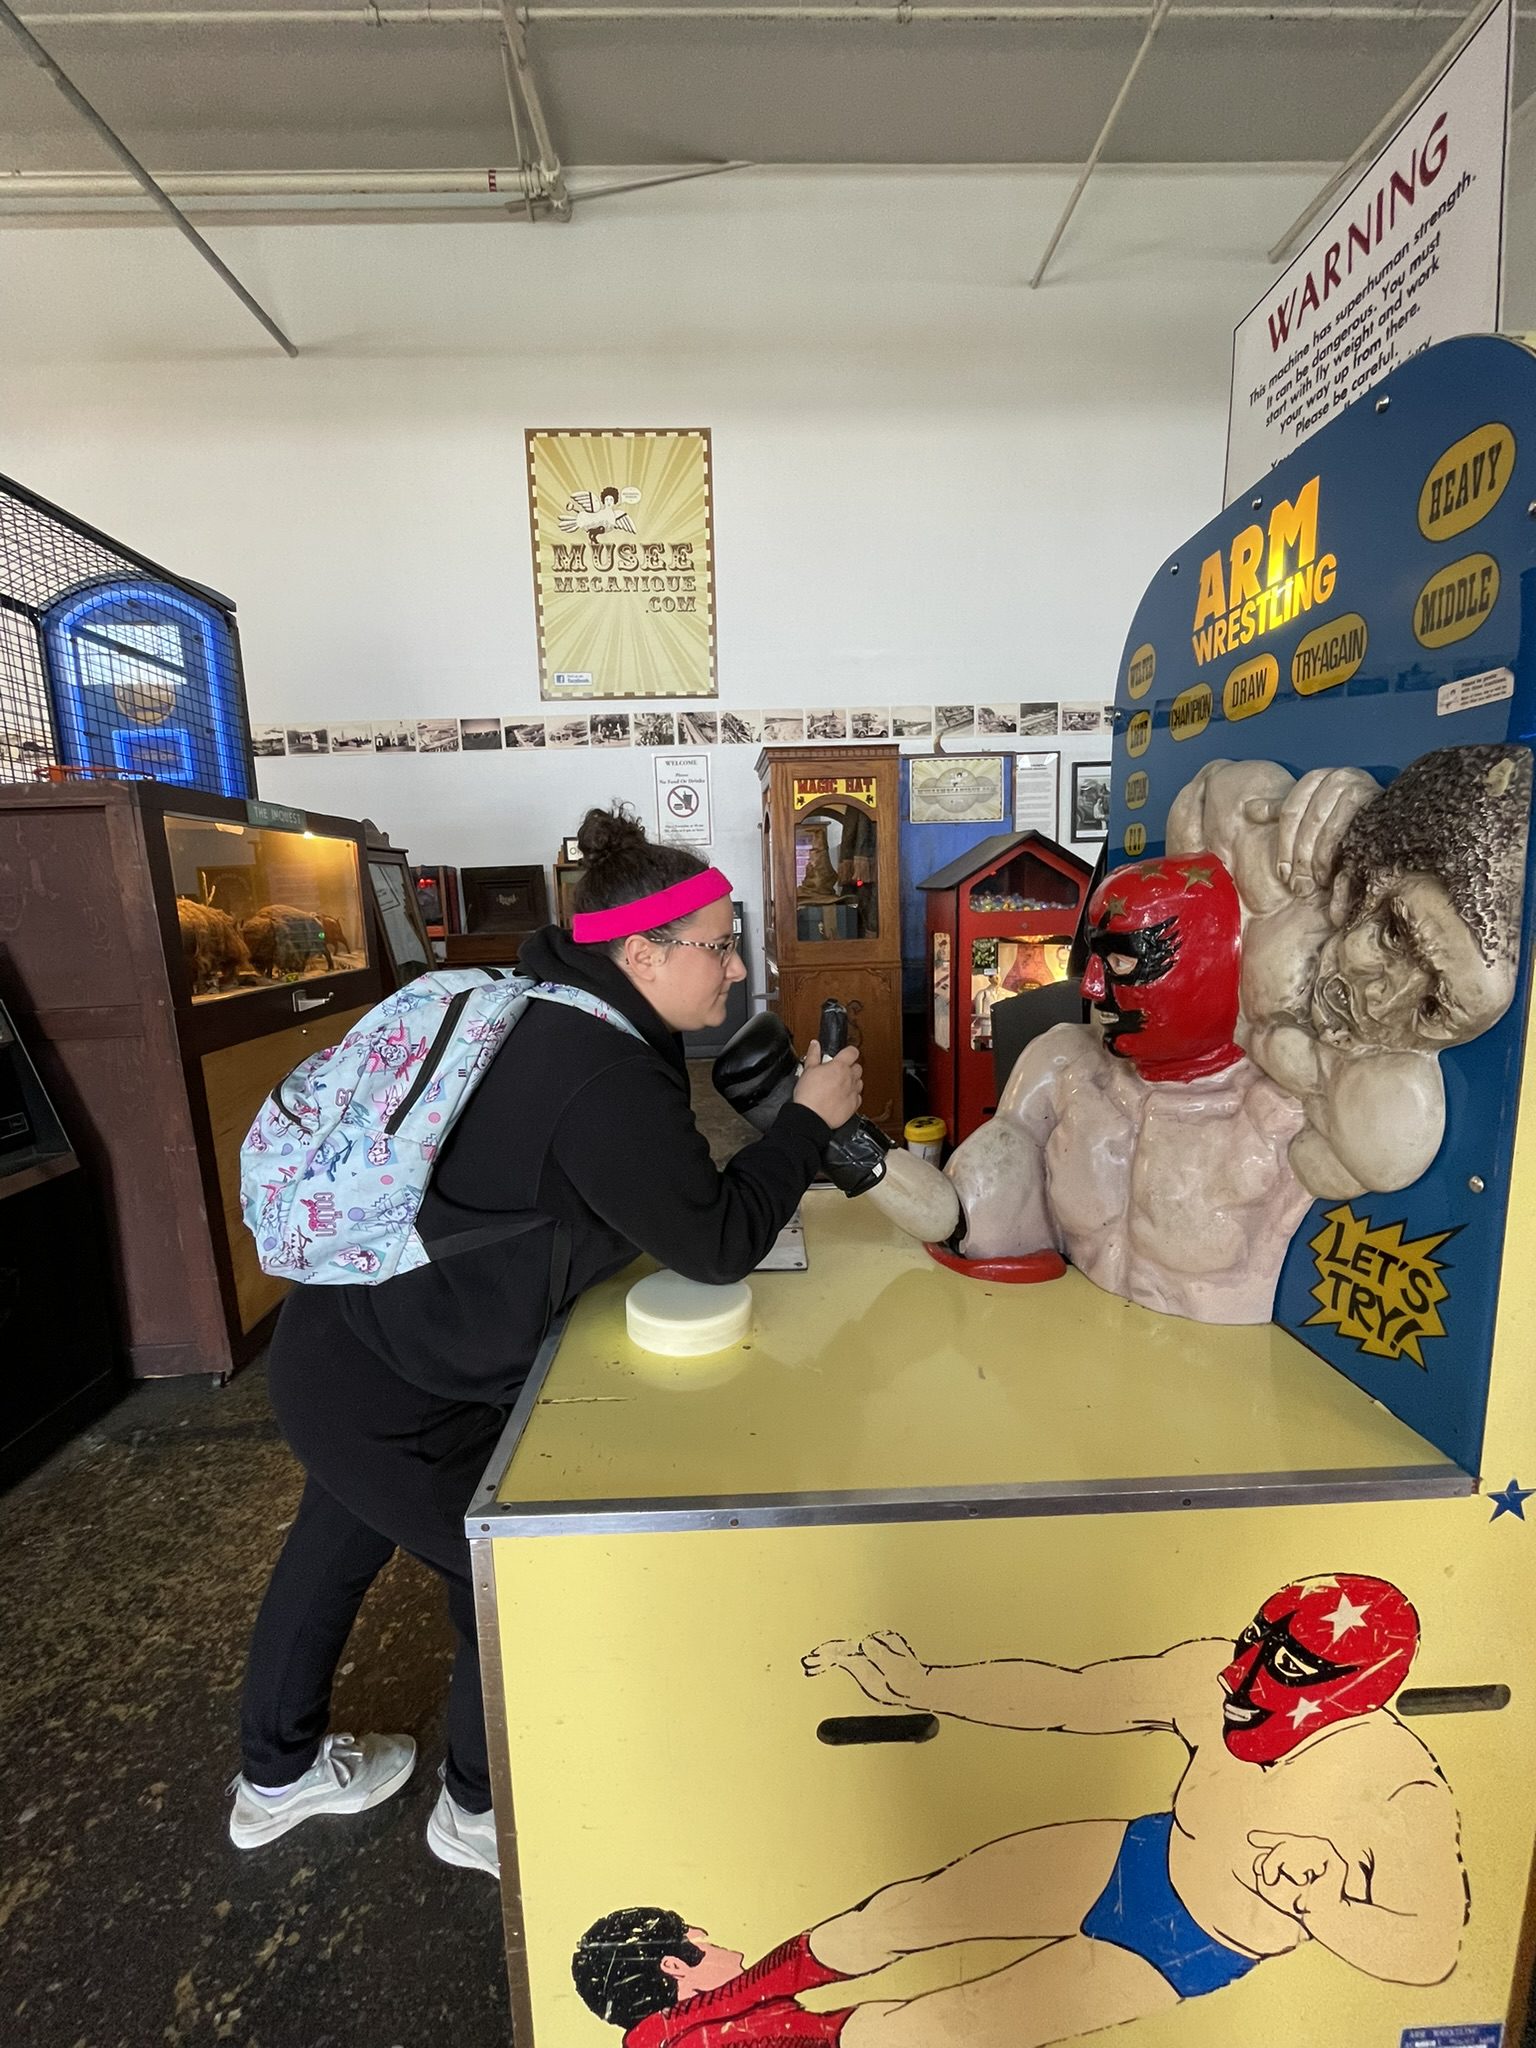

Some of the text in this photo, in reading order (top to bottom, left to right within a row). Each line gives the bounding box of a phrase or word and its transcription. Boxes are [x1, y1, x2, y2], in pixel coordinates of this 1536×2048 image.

[1268, 111, 1448, 353] WARNING
[1249, 170, 1477, 407] This machine has superhuman strength.
[1266, 395, 1273, 411] It
[1275, 380, 1293, 402] can
[1295, 365, 1309, 383] be
[1311, 303, 1378, 368] dangerous.
[1381, 271, 1406, 302] You
[1409, 230, 1441, 276] must
[1265, 400, 1287, 428] start
[1289, 376, 1313, 405] with
[1315, 362, 1330, 383] fly
[1333, 320, 1374, 367] weight
[1377, 289, 1403, 327] and
[1406, 254, 1440, 299] work
[1279, 404, 1303, 435] your
[1306, 380, 1331, 409] way
[1334, 365, 1349, 385] up
[1352, 337, 1382, 370] from
[1385, 302, 1421, 342] there.
[1295, 402, 1330, 438] Please
[1332, 388, 1348, 407] be
[1351, 341, 1399, 392] careful.
[1428, 440, 1504, 525] HEAVY
[551, 543, 696, 573] MUSEE
[553, 576, 697, 594] MECANIQUE
[1193, 475, 1321, 632] ARM
[645, 596, 697, 614] .COM
[1191, 553, 1337, 667] WRESTLING
[1419, 565, 1493, 637] MIDDLE
[1130, 653, 1154, 689] WELTER
[1169, 692, 1213, 732] CHAMPION
[1231, 667, 1268, 709] DRAW
[665, 759, 698, 767] WELCOME
[797, 778, 873, 794] MAGIC HAT
[253, 805, 301, 825] THE INQUEST
[1324, 1221, 1433, 1315] LET'S
[1326, 1269, 1425, 1352] TRY!
